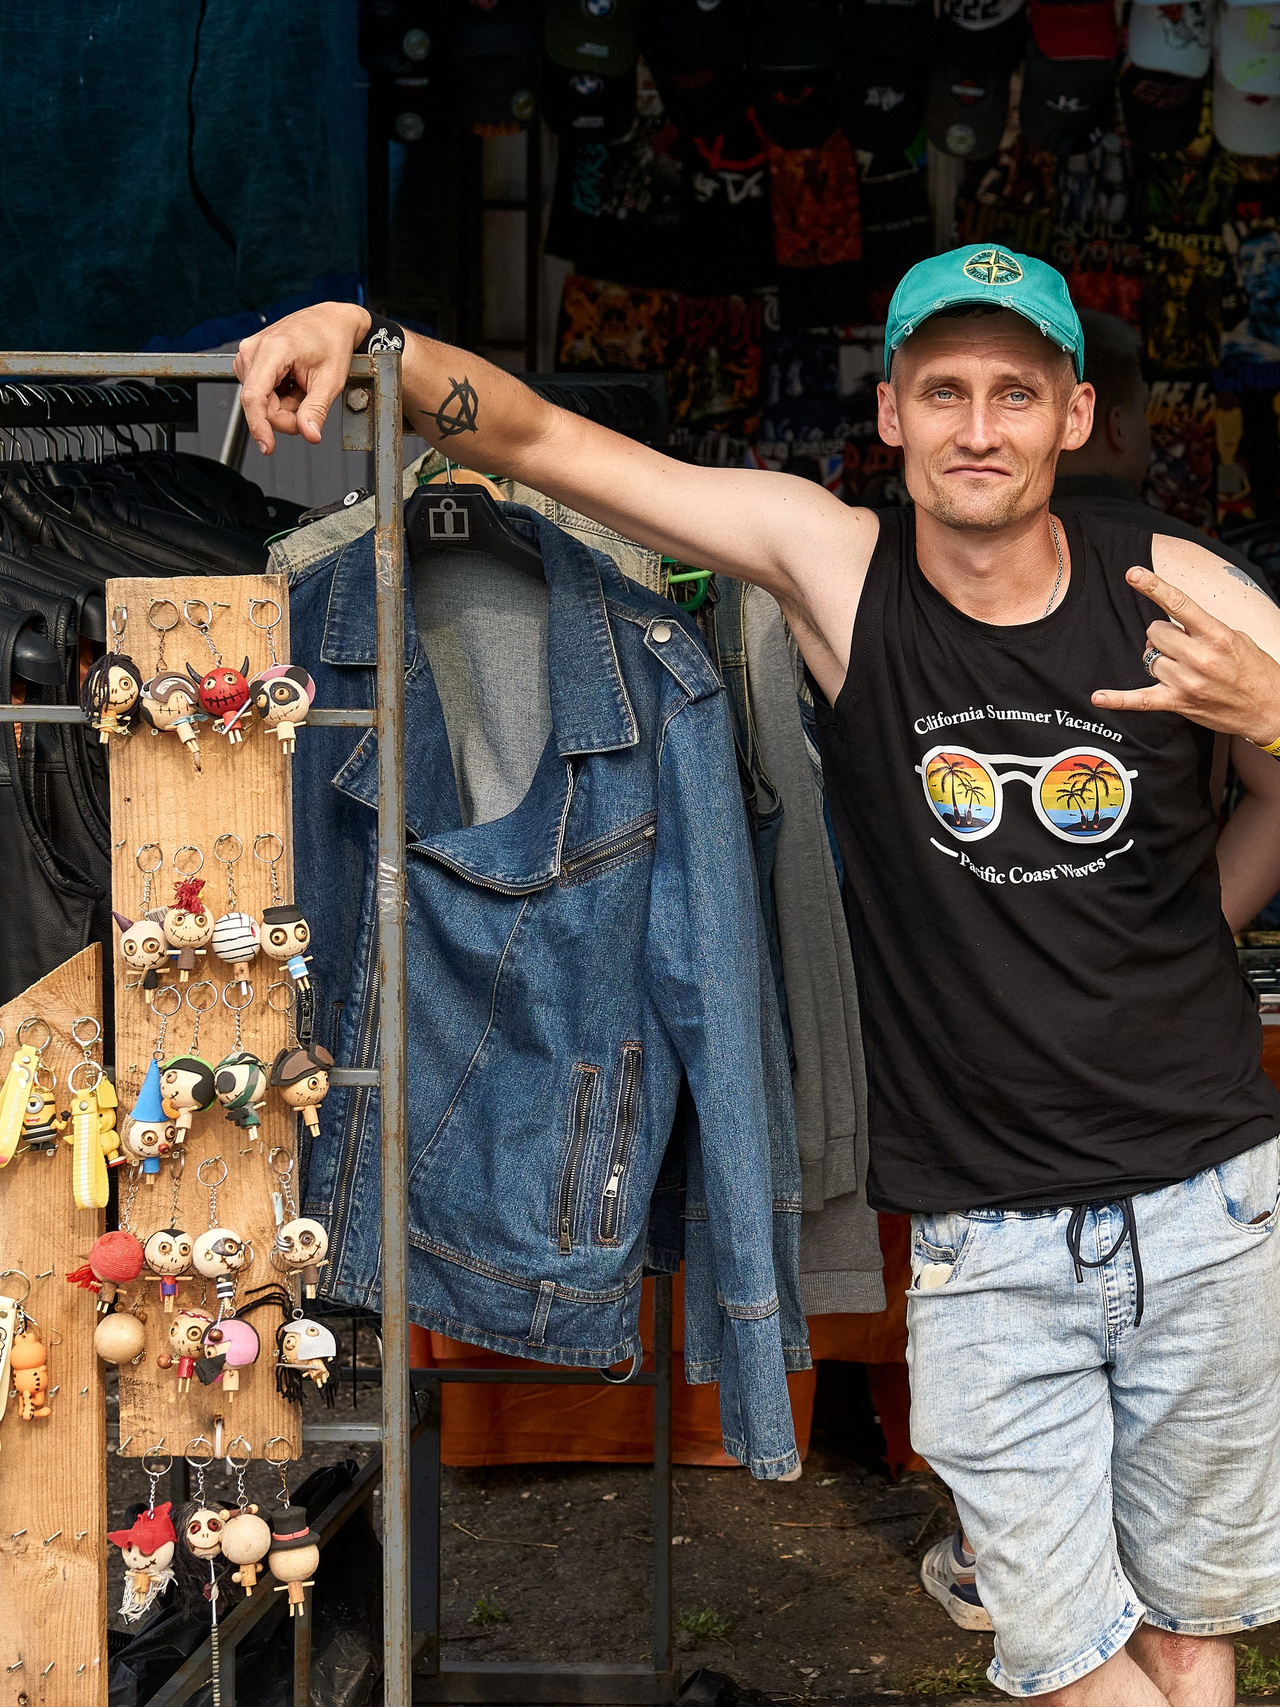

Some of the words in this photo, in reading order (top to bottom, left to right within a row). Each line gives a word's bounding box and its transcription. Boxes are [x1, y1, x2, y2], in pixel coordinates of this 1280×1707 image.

[986, 704, 1052, 724] Summer
[1054, 709, 1123, 744] Vacation
[959, 851, 1006, 885] Pacific
[1008, 866, 1059, 885] Coast
[1055, 857, 1106, 879] Waves
